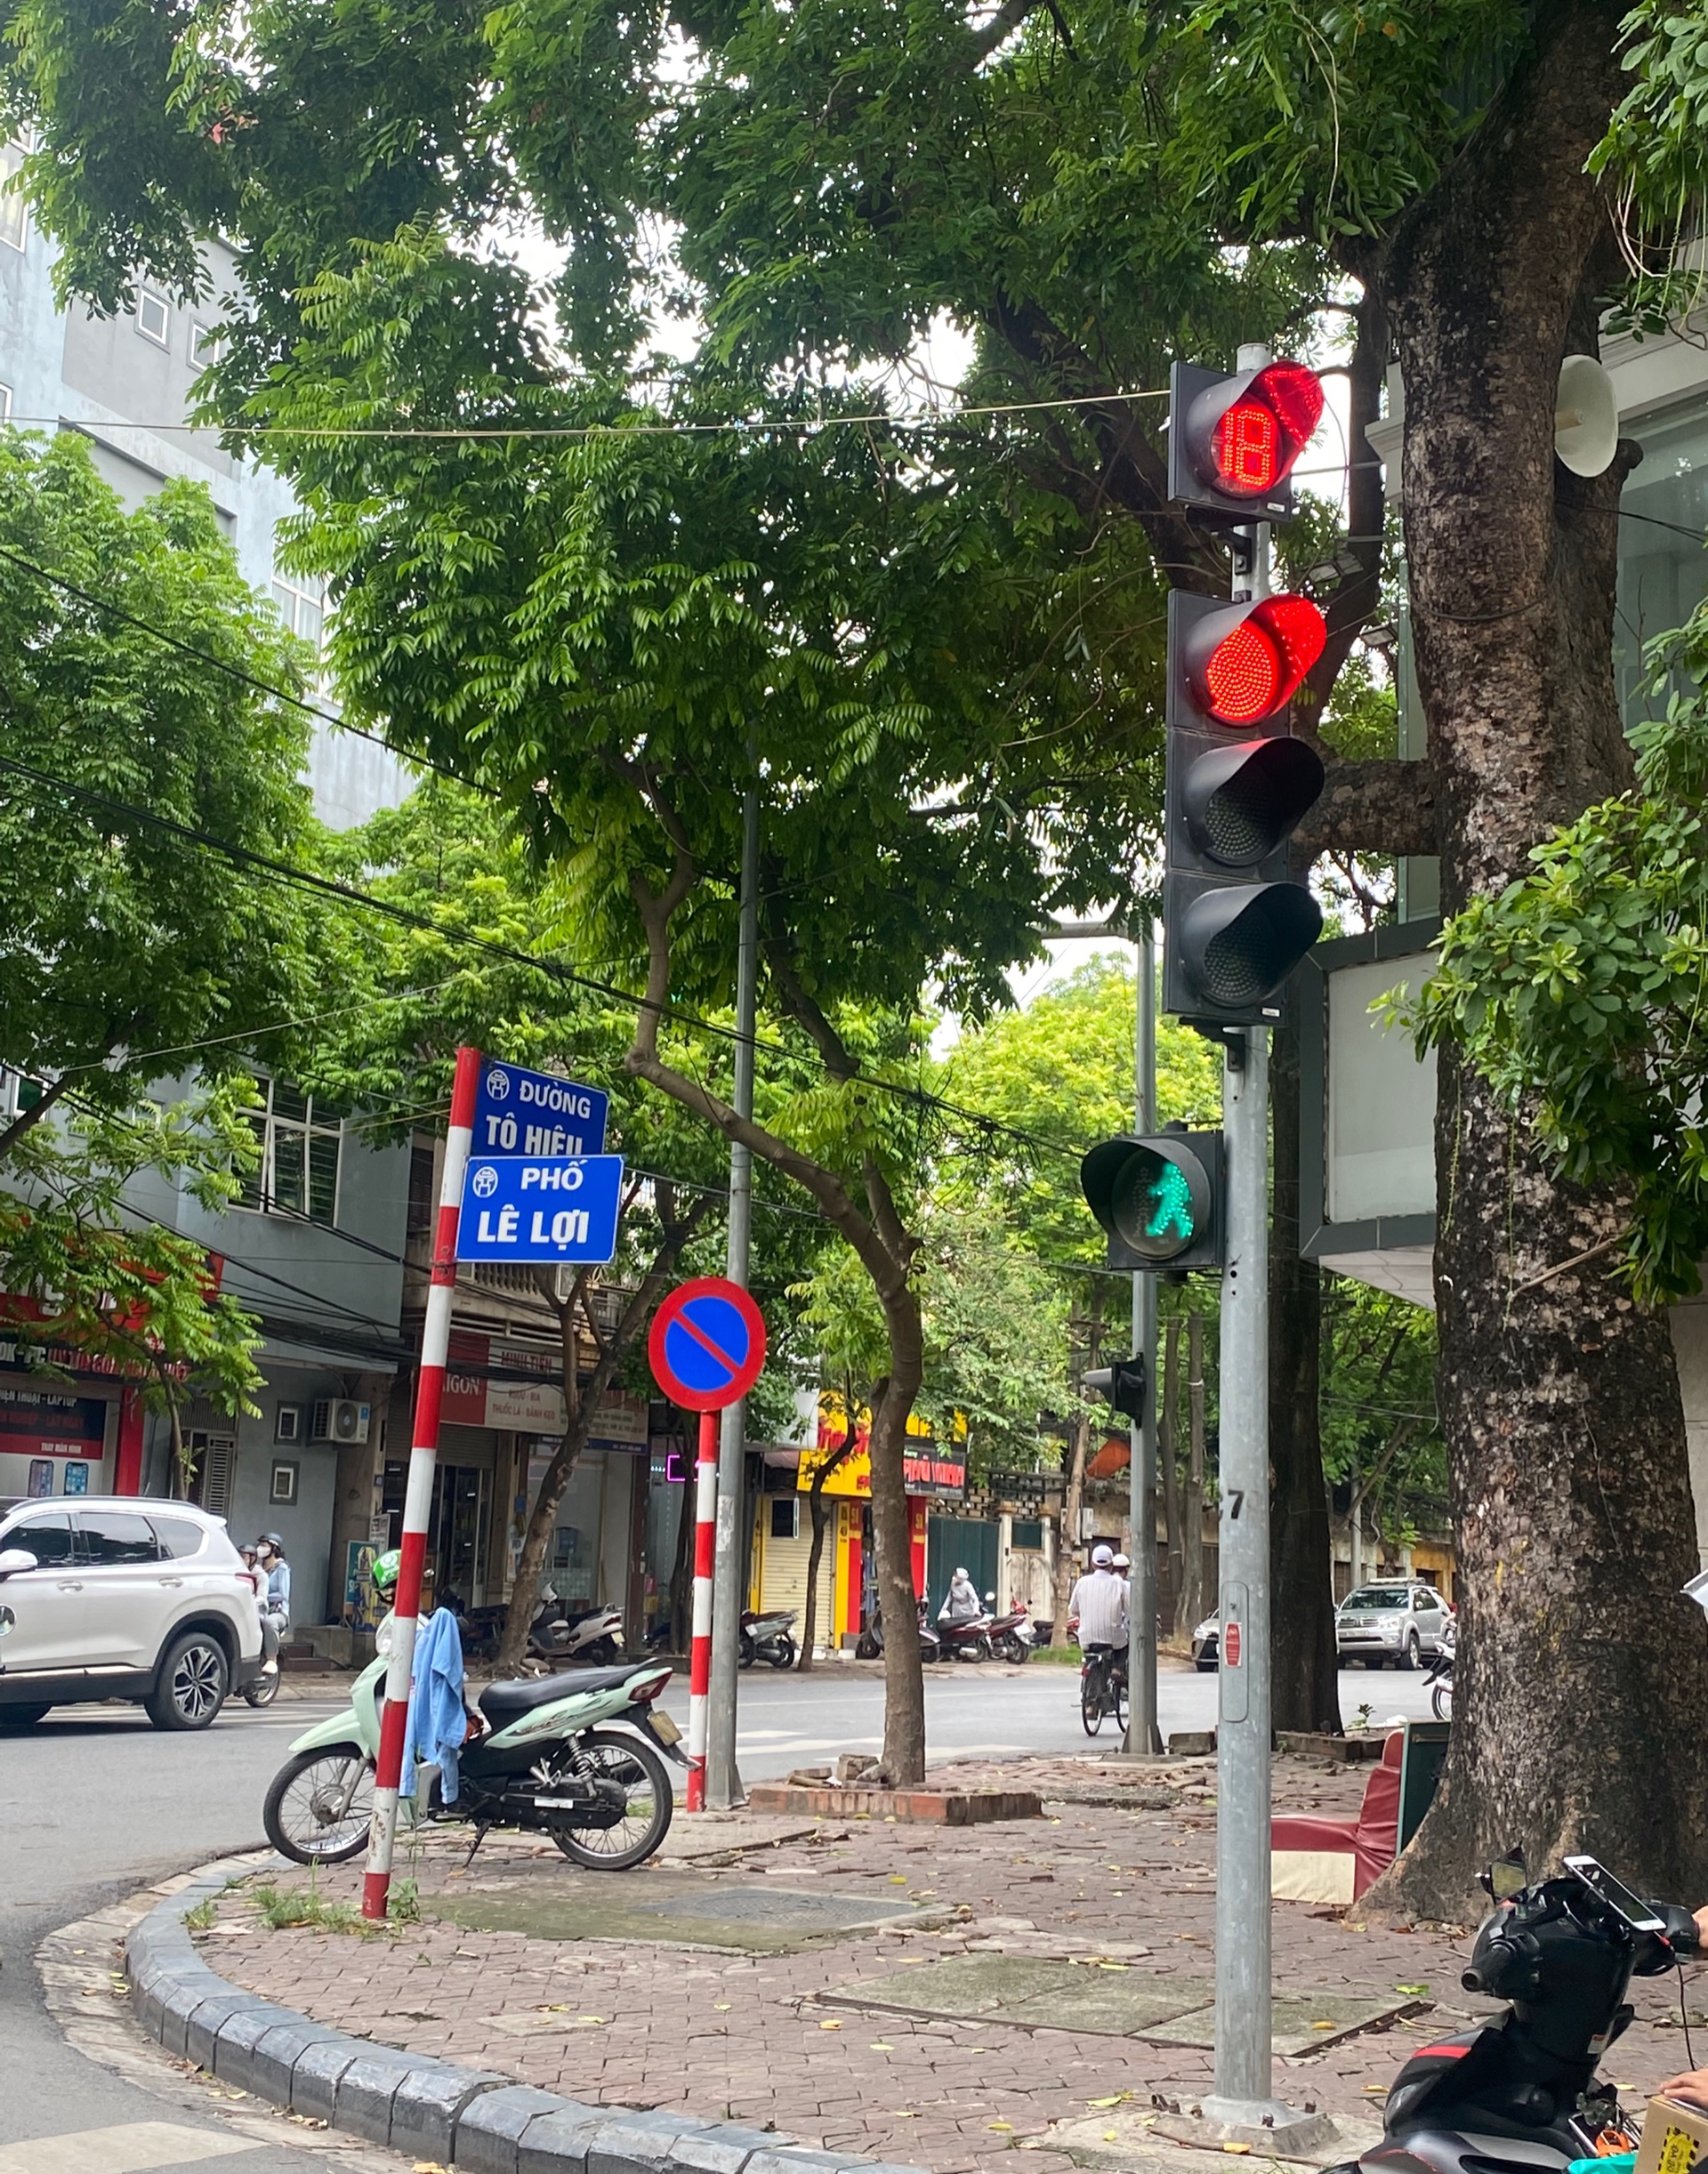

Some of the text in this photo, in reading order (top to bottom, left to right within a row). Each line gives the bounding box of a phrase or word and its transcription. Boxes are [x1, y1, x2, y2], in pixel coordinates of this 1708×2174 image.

[1223, 408, 1271, 487] 18
[520, 1080, 591, 1119] ĐƯỜNG
[486, 1112, 518, 1150] TÔ
[520, 1159, 588, 1191] PHỐ
[477, 1204, 590, 1251] LÊ LỢI
[442, 1373, 479, 1396] IGON
